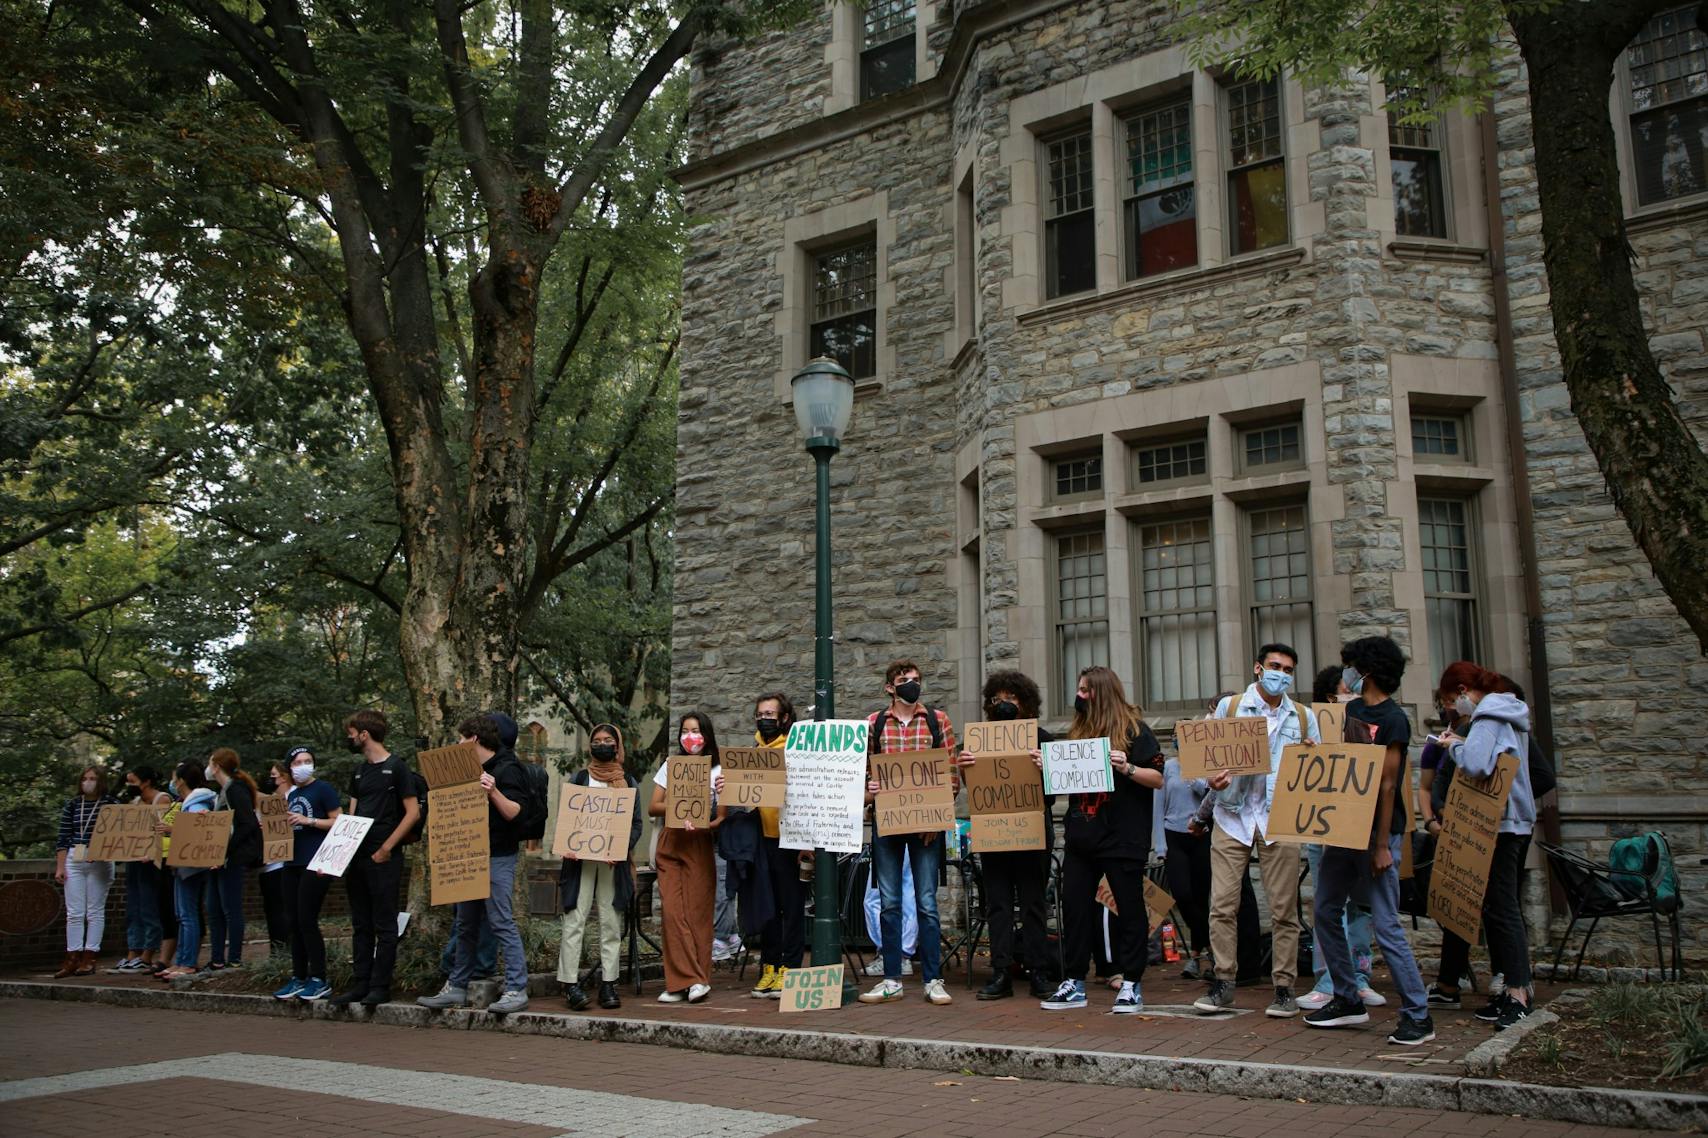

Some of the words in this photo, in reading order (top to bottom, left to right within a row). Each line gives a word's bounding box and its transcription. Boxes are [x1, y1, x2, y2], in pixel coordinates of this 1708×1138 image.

[786, 724, 867, 753] DEMANDS
[969, 722, 1034, 753] SILENCE
[1181, 722, 1225, 744] PENN
[1228, 721, 1267, 738] TAKE
[725, 751, 781, 769] STAND
[1051, 742, 1096, 761] SILENCE
[1204, 740, 1261, 768] ACTION!
[421, 748, 481, 785] DEMANDS
[672, 762, 708, 782] CASTLE
[877, 762, 904, 790] NO
[911, 760, 944, 786] ONE
[993, 759, 1010, 779] IS
[1288, 754, 1375, 795] JOIN
[1050, 770, 1104, 790] COMPLICIT
[673, 784, 706, 797] MUST
[738, 785, 763, 804] US
[899, 794, 924, 806] DID
[973, 784, 1039, 811] COMPLICIT
[261, 798, 288, 815] CASTLE
[568, 793, 628, 813] CASTLE
[675, 800, 705, 820] GO!
[268, 820, 288, 834] MUST
[573, 816, 612, 830] MUST
[881, 808, 952, 827] ANYTHING
[984, 818, 1008, 827] JOIN
[1015, 816, 1028, 827] US
[1296, 803, 1336, 836] US
[334, 819, 367, 840] CASTLE
[100, 836, 155, 859] HATE?
[269, 842, 288, 860] GO!
[313, 843, 343, 863] MUST
[567, 831, 614, 856] GO!
[784, 968, 841, 989] JOIN
[795, 989, 824, 1009] US
